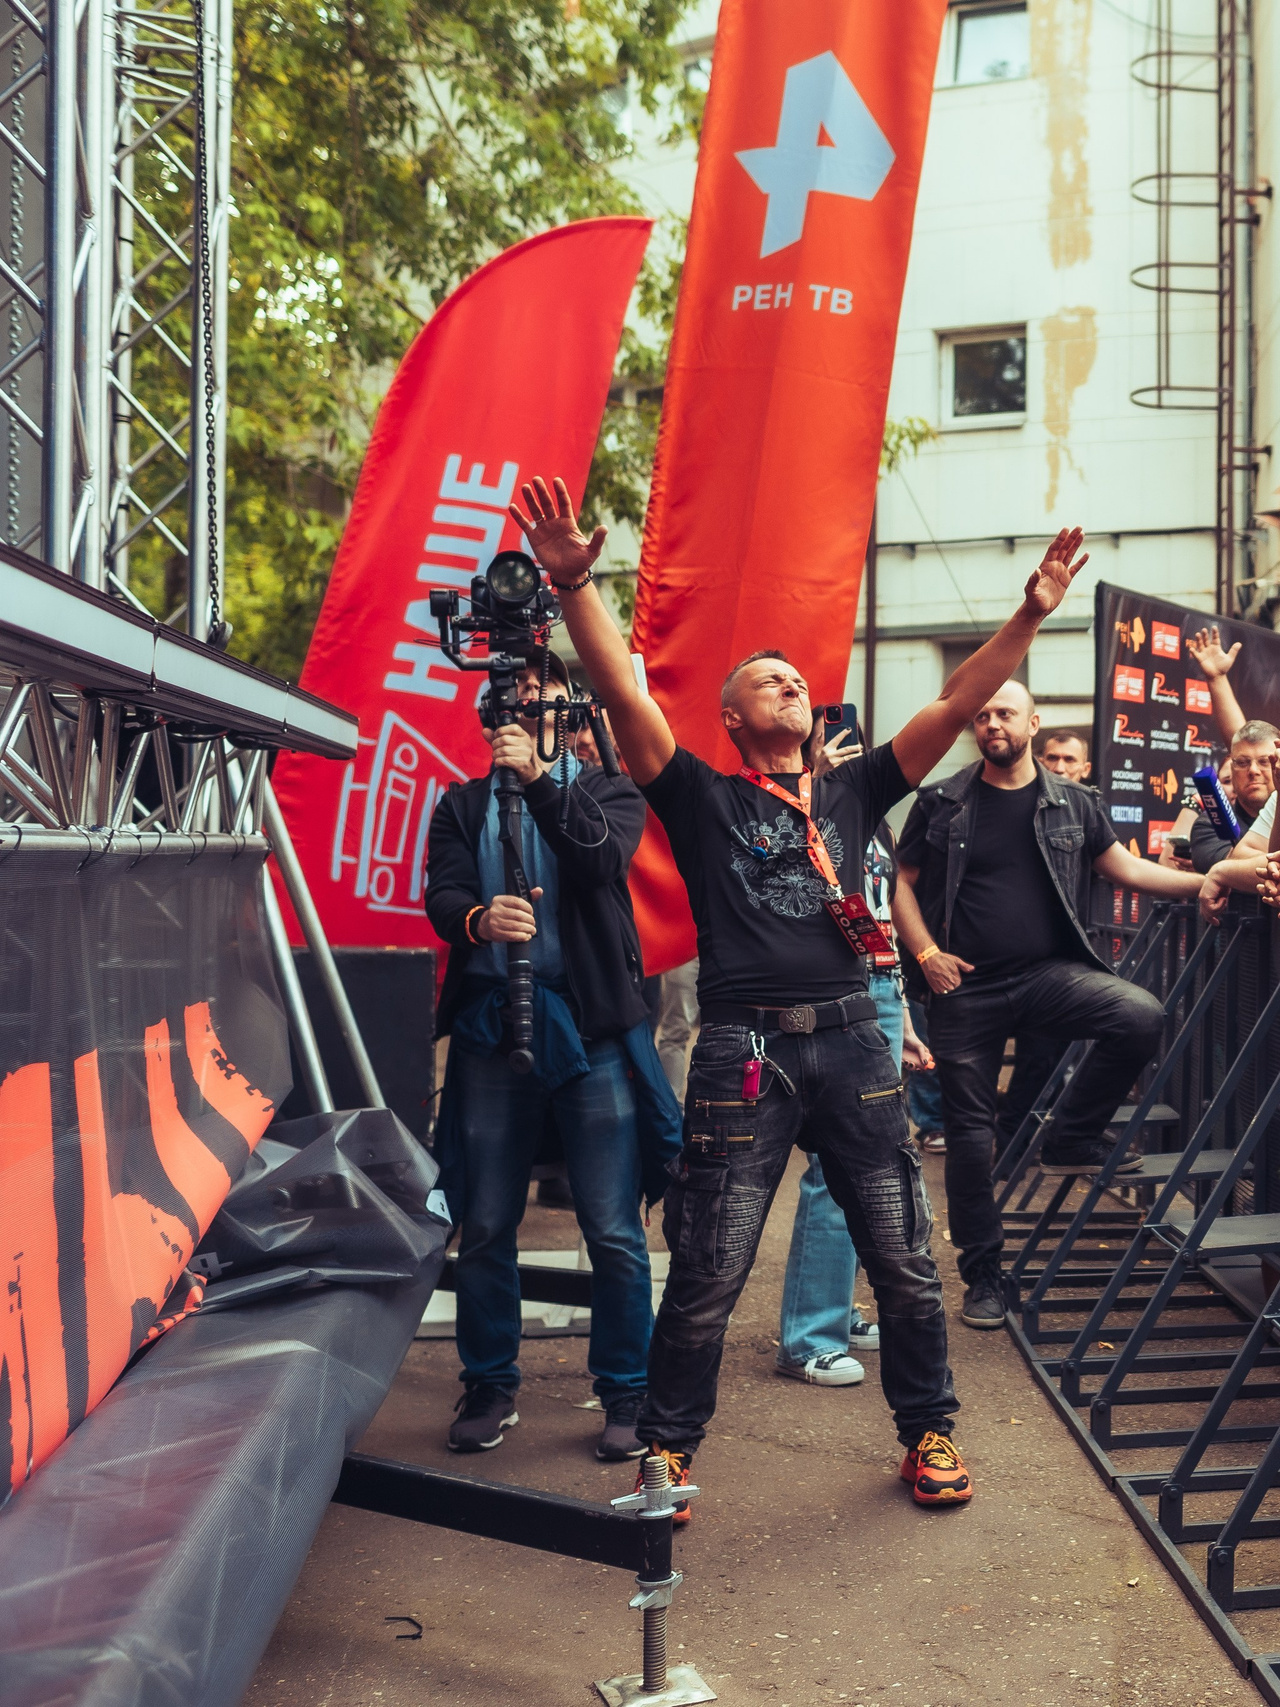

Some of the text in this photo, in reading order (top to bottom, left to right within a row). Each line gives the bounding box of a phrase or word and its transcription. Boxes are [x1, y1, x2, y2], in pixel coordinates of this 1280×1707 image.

[732, 282, 853, 315] РЕН ТВ
[383, 454, 519, 702] НАШЕ
[830, 903, 867, 953] BOSS
